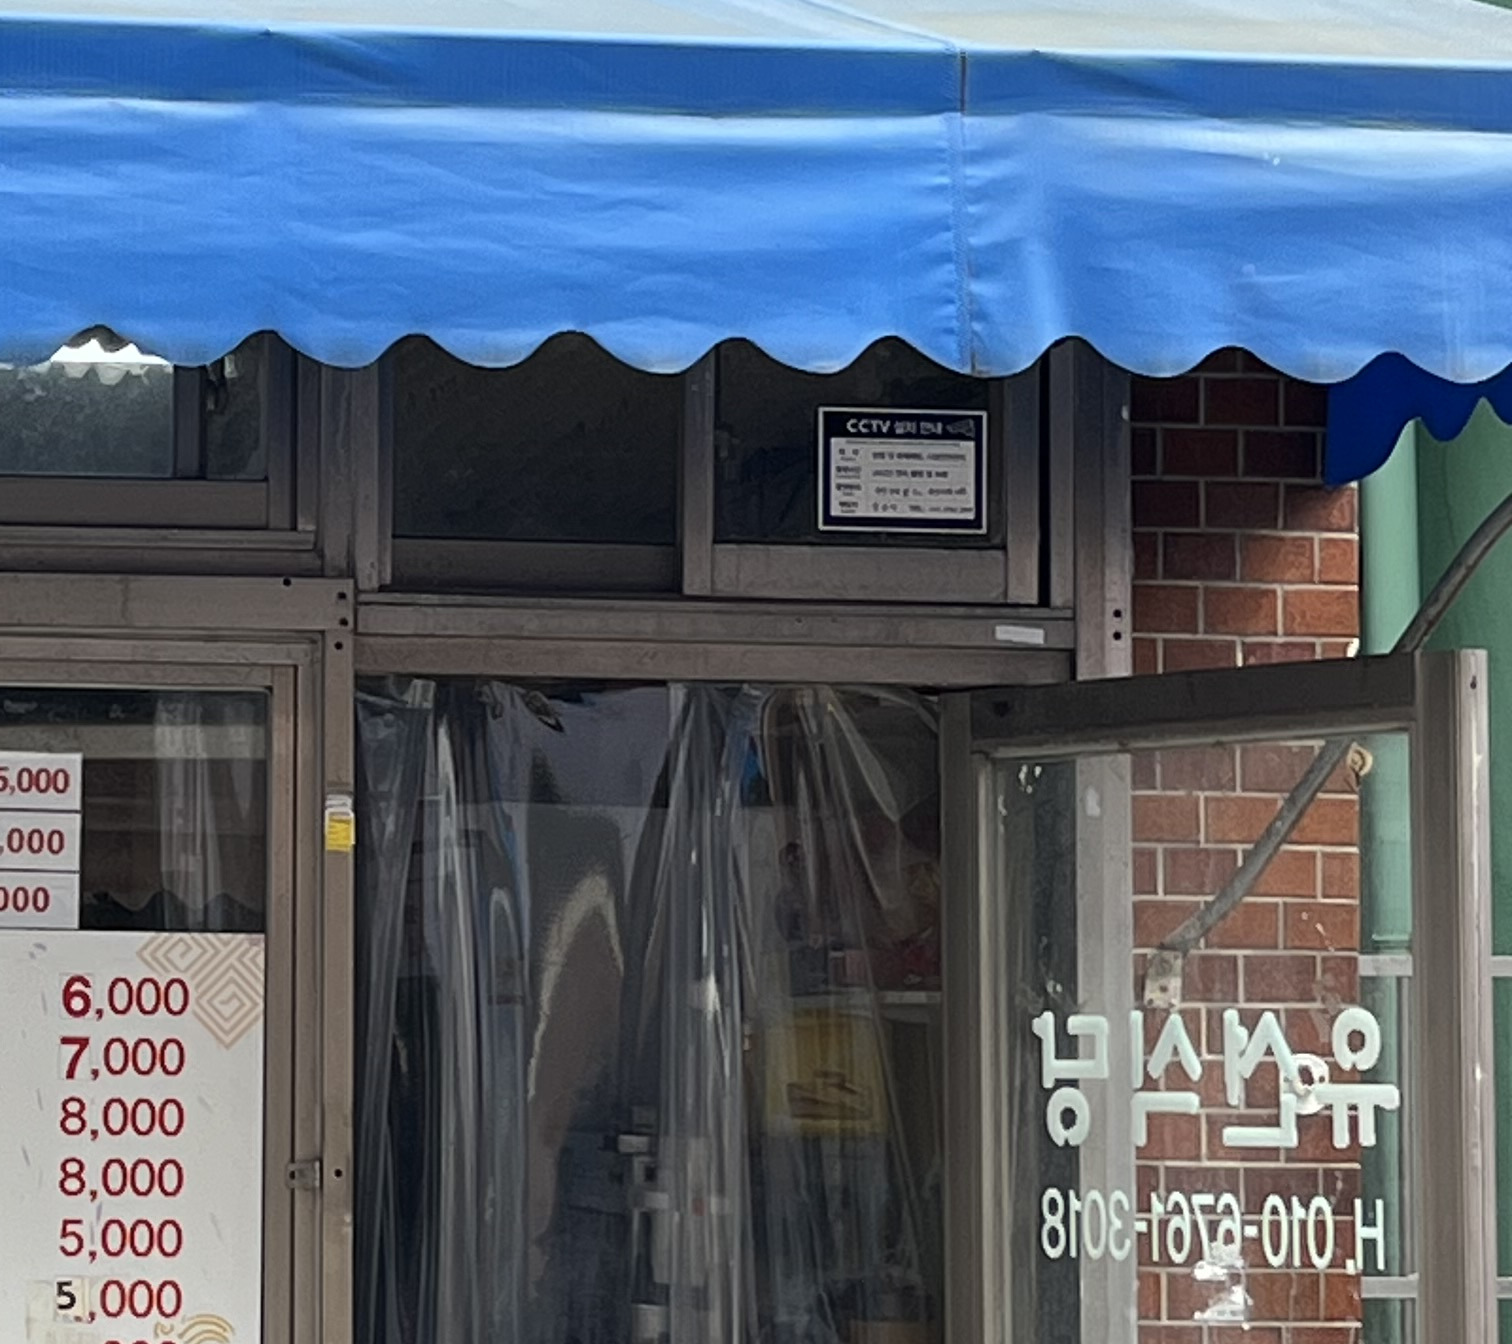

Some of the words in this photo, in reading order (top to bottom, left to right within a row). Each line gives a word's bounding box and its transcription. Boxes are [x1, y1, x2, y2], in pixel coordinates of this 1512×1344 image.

[846, 419, 890, 433] CCTV
[62, 976, 190, 1023] 6,000
[60, 1036, 186, 1083] 7,000
[60, 1097, 186, 1142] 8,000
[59, 1158, 185, 1204] 8,000
[59, 1218, 184, 1264] 5,000
